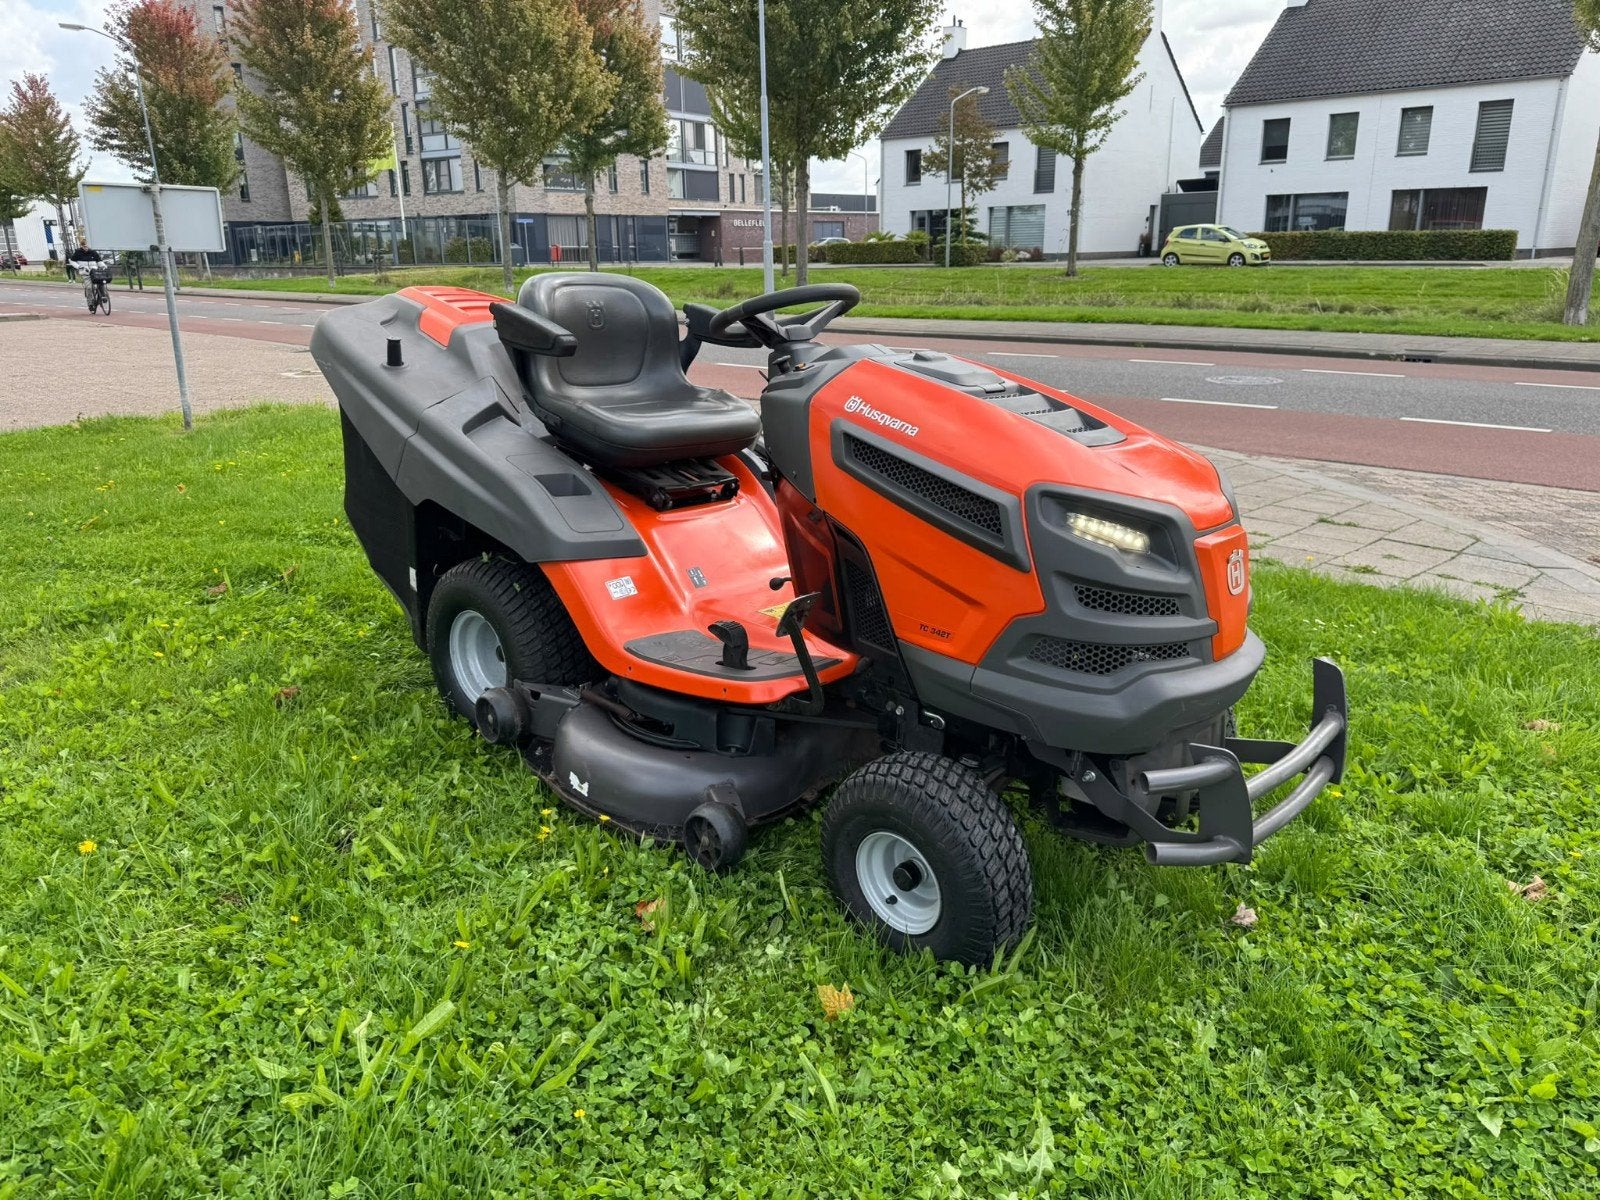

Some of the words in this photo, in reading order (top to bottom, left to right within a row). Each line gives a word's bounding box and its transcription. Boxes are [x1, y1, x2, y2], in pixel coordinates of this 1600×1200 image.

[856, 401, 919, 437] Husqvarna
[919, 623, 929, 632] TC
[930, 627, 951, 639] 342T
